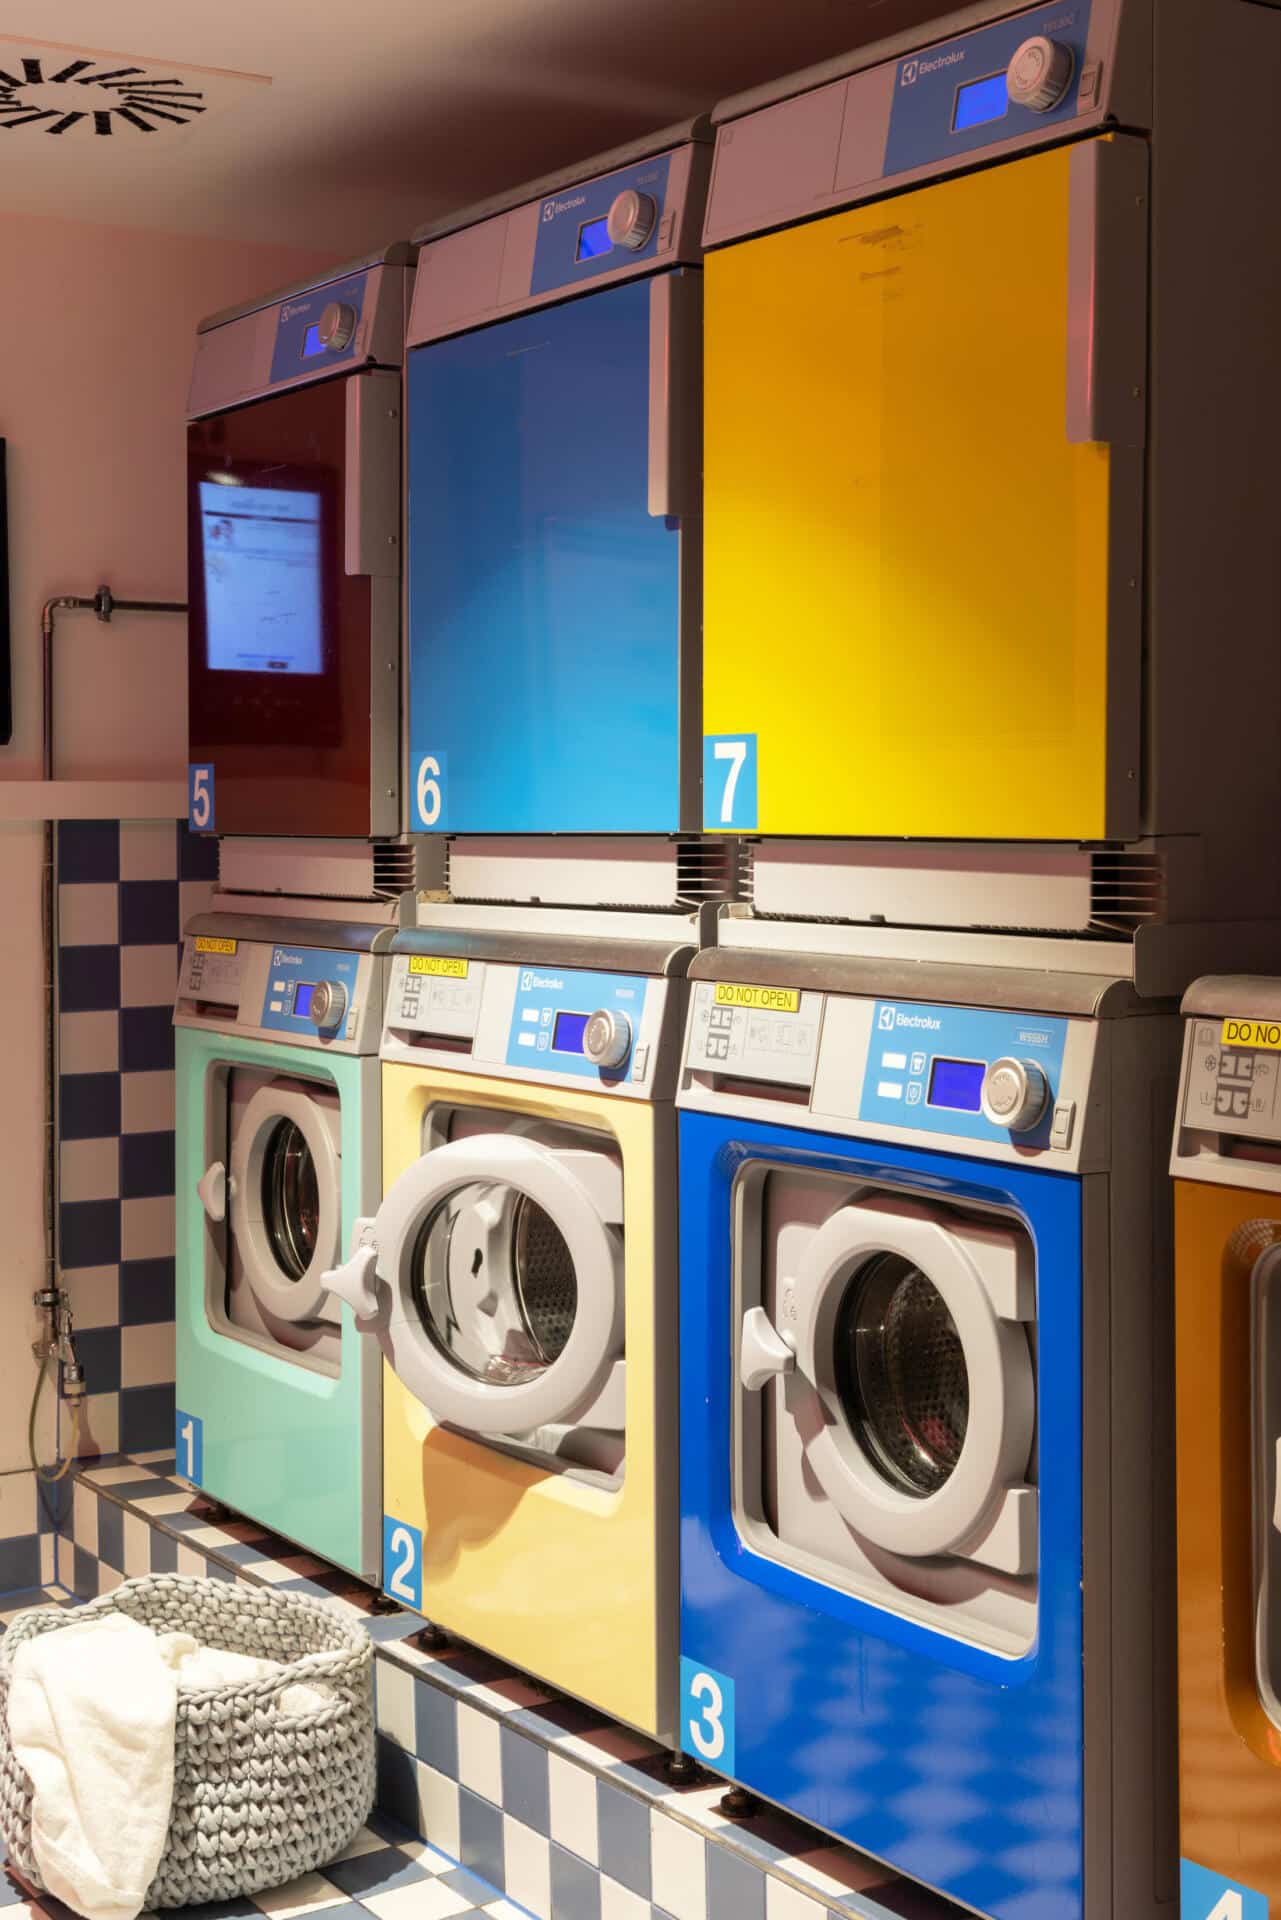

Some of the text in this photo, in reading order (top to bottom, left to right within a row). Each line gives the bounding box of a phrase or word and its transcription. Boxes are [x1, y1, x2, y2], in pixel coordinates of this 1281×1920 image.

[919, 51, 965, 75] Electrolux
[193, 769, 210, 826] 5
[417, 756, 441, 825] 6
[714, 742, 747, 822] 7
[412, 957, 465, 975] DO NOT OPEN
[718, 986, 793, 1008] DO NOT OPEN
[896, 1013, 941, 1031] Electrolux
[1227, 1023, 1251, 1041] DO
[182, 1420, 193, 1477] 1
[390, 1527, 415, 1602] 2
[689, 1672, 725, 1759] 3
